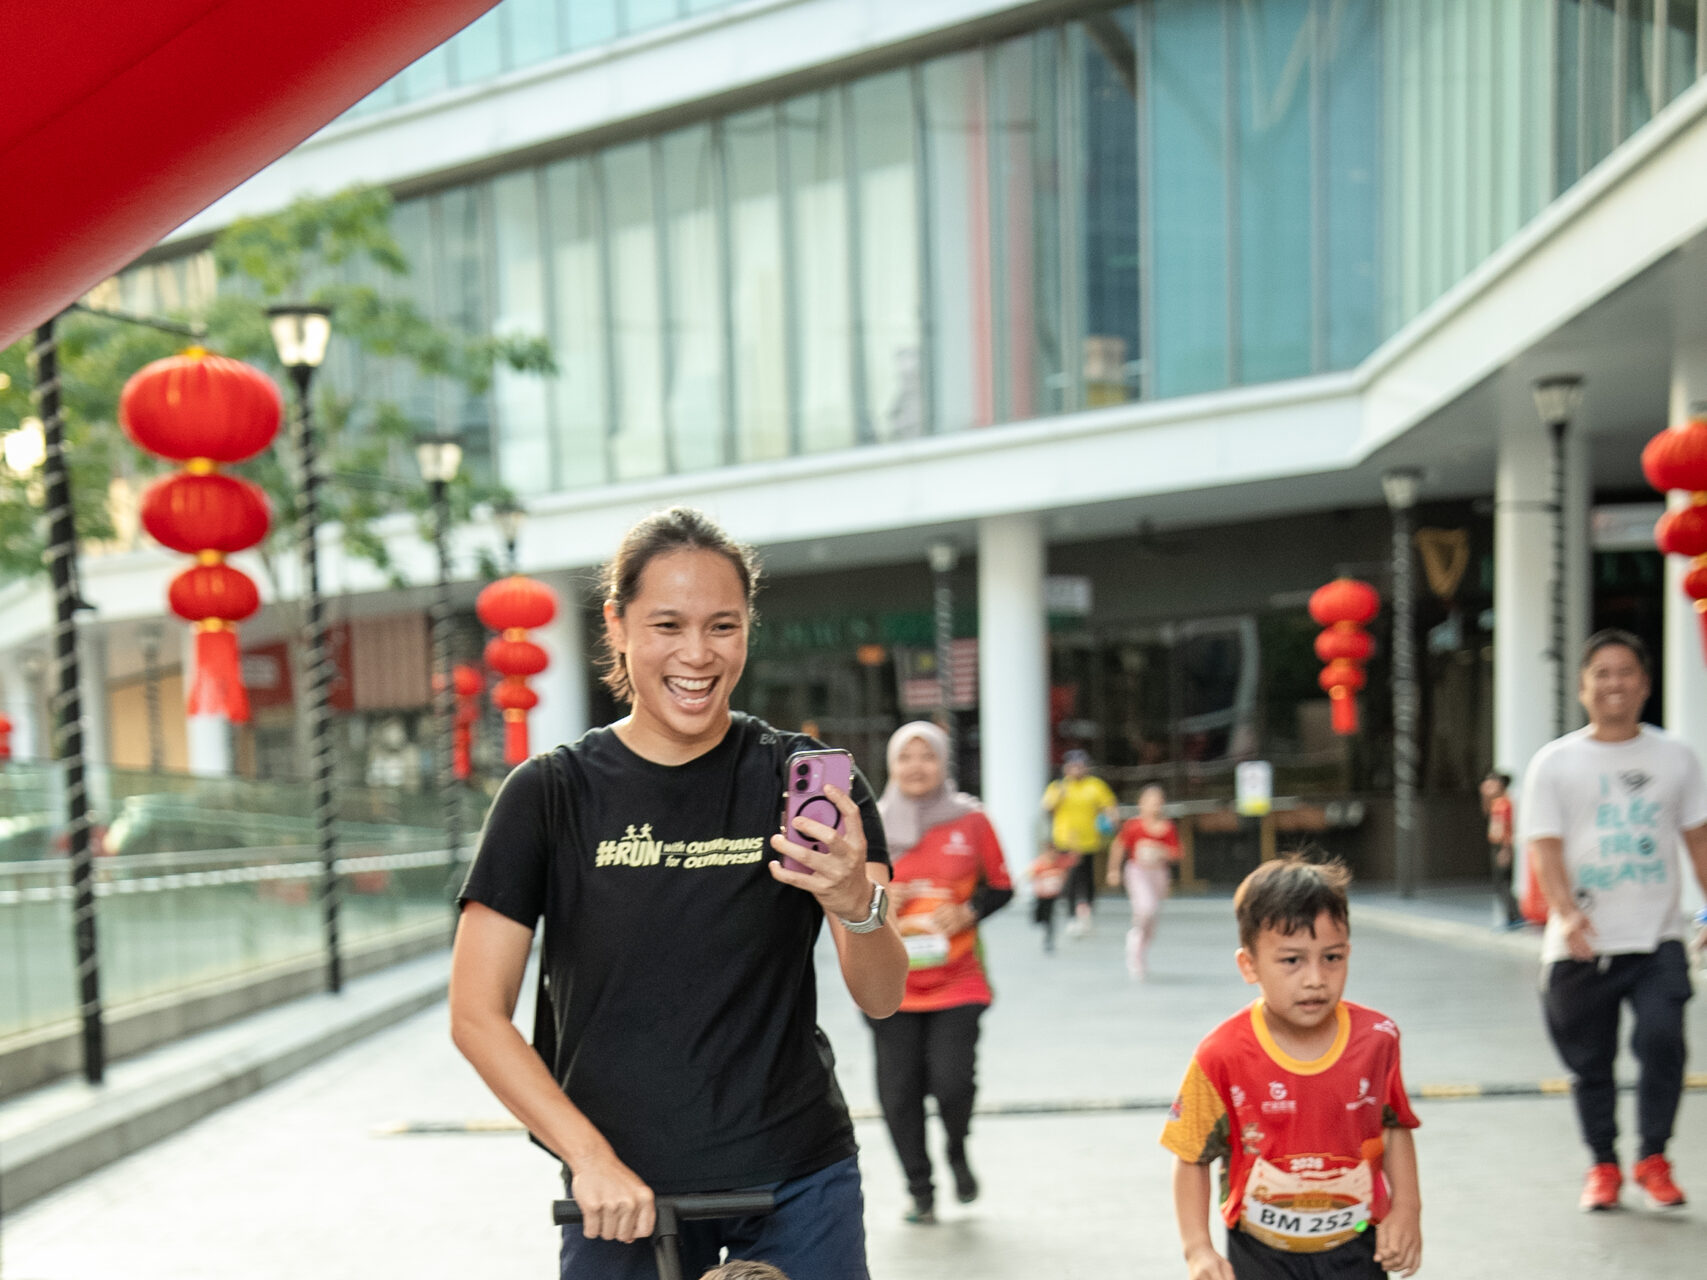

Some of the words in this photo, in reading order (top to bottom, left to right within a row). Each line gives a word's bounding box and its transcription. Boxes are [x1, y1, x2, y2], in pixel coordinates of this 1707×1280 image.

[595, 840, 664, 867] #RUN
[663, 841, 686, 853] with
[686, 837, 765, 854] OLYMPIANS
[665, 854, 681, 867] for
[683, 850, 763, 869] OLYMPISM
[1260, 1208, 1301, 1232] BM
[1308, 1211, 1354, 1233] 252
